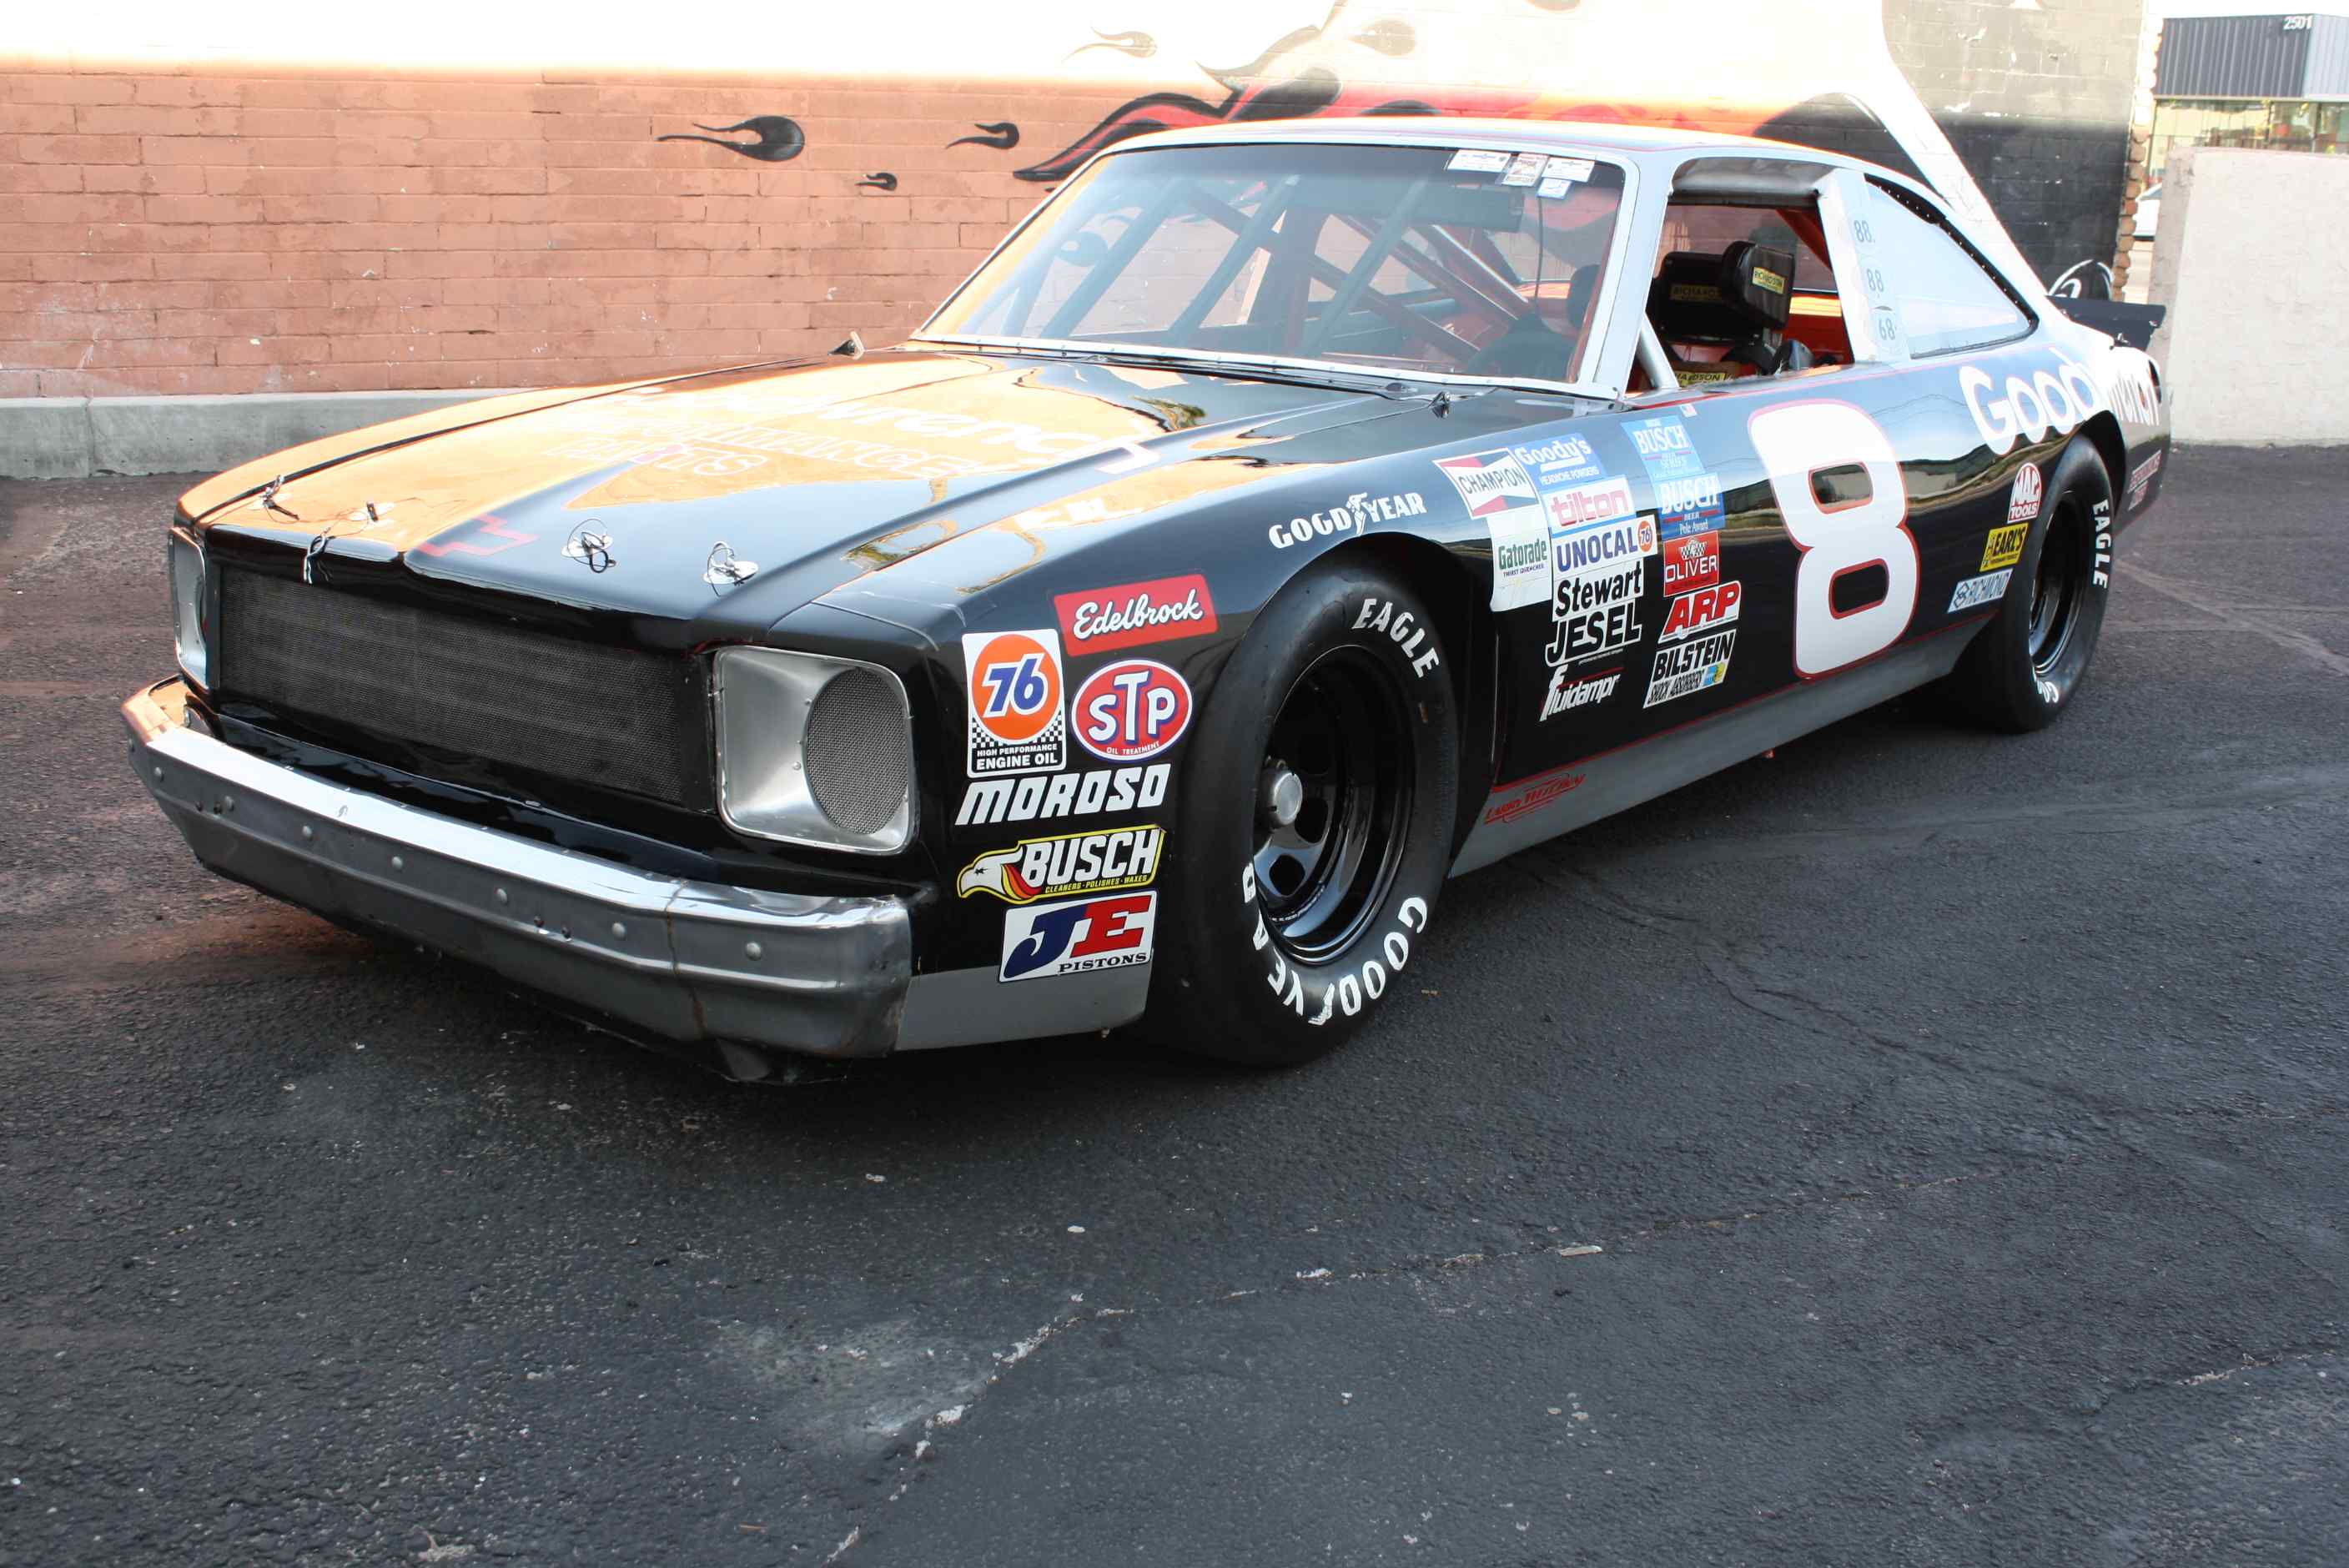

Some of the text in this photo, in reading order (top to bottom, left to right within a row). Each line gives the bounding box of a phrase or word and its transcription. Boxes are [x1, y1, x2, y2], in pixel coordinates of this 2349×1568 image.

[2283, 15, 2313, 30] 2501
[1867, 269, 1884, 292] 88
[1514, 437, 1592, 465] Goody's
[1632, 424, 1692, 455] BUSCH
[1458, 466, 1527, 495] CHAMPION
[1660, 475, 1721, 515] BUSCH
[2010, 465, 2040, 508] MAC
[1268, 492, 1428, 549] GOODYEAR
[1551, 490, 1629, 526] tilton
[2009, 502, 2038, 520] TOOLS
[1498, 538, 1548, 570] Gatorade
[1556, 525, 1653, 572] UNOCAL 76
[1747, 398, 1921, 680] 8
[2092, 499, 2112, 589] EAGLE
[1555, 560, 1642, 617] Stewart
[1664, 555, 1718, 584] OLIVER
[1073, 588, 1204, 640] Edelbrock
[1663, 582, 1741, 637] ARP
[1351, 597, 1440, 678] EAGLE
[1544, 598, 1643, 667] JESEL
[1652, 631, 1736, 682] BILSTEIN
[982, 652, 1049, 719] 76
[1088, 669, 1177, 742] STP
[976, 753, 1058, 771] ENGINE OIL
[977, 742, 1058, 757] HIGH PERFORMANCE
[1106, 746, 1119, 755] OIL
[954, 763, 1172, 826] MOROSO
[1020, 828, 1160, 887] BUSCH
[1003, 894, 1153, 979] JE
[1057, 952, 1148, 973] PISTONS
